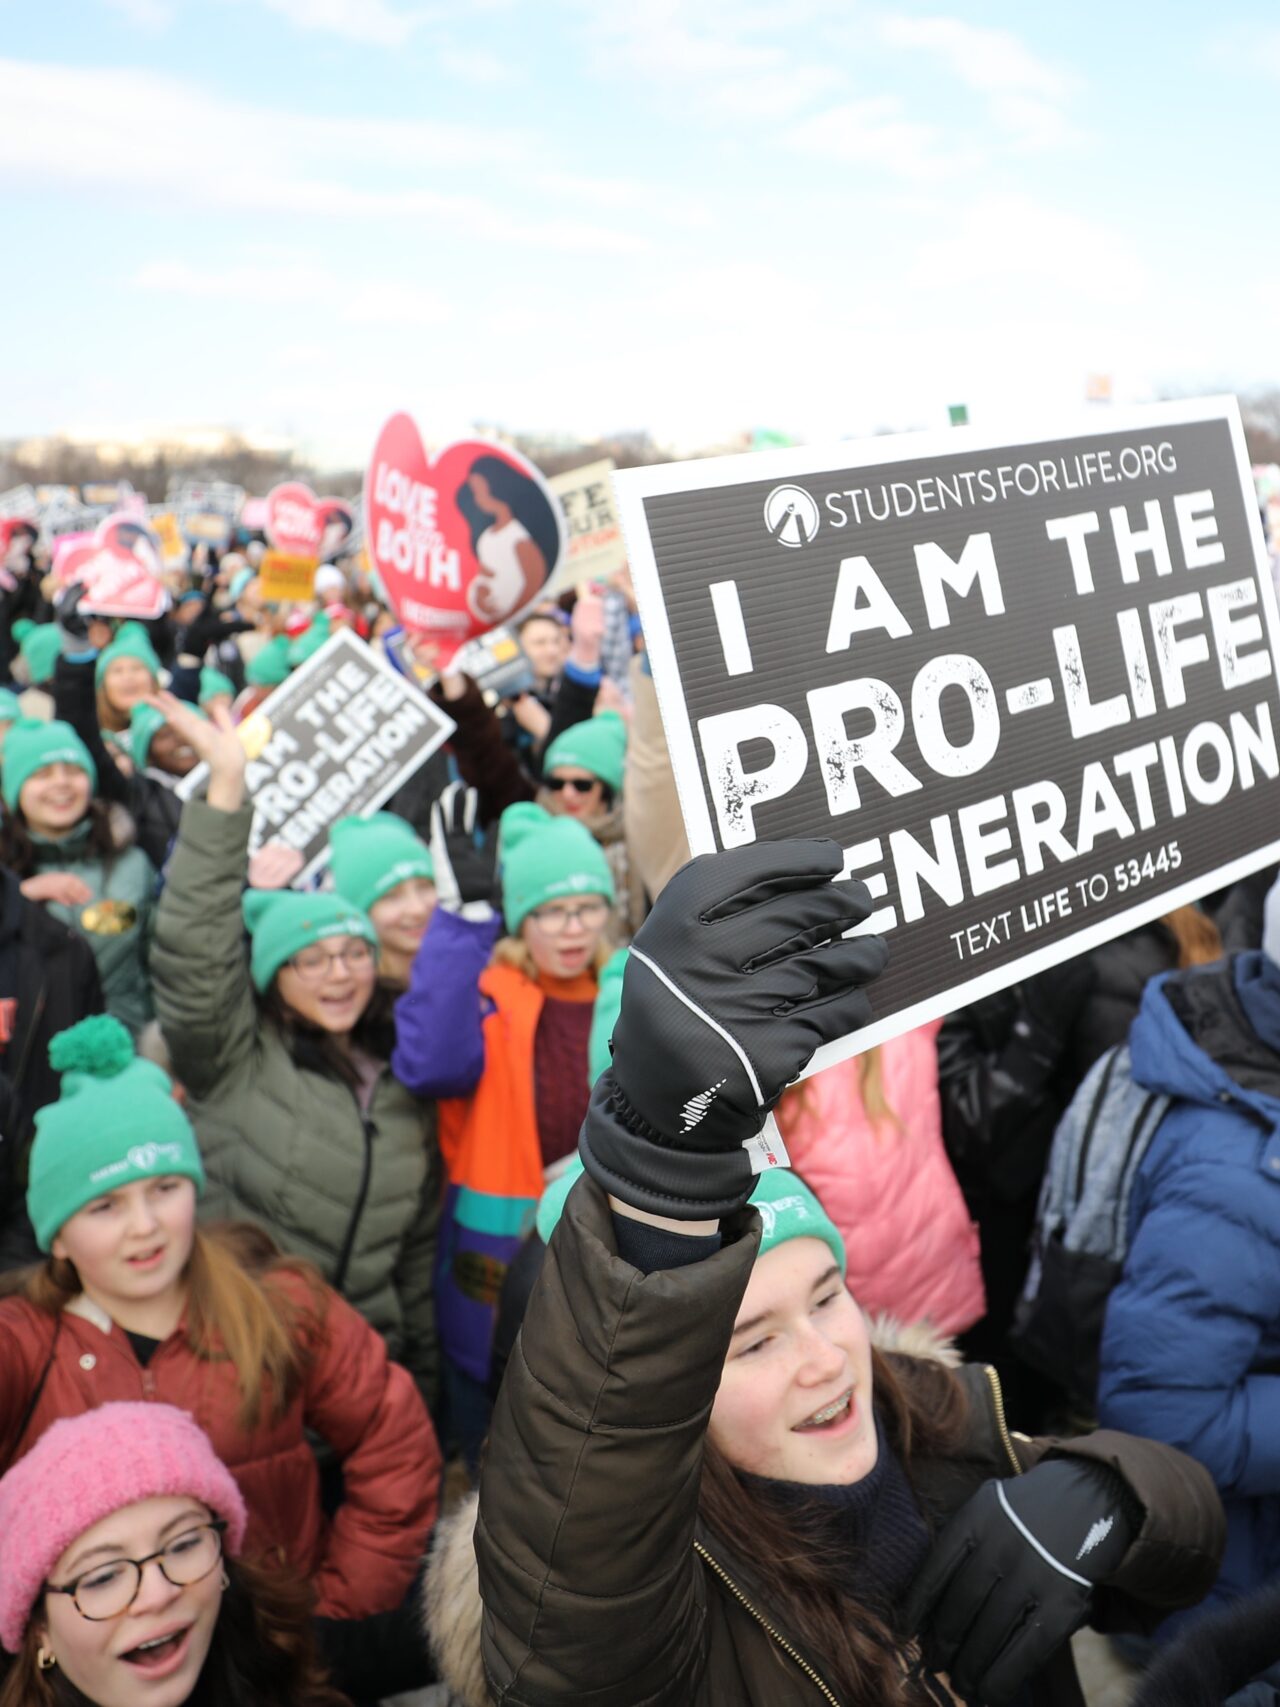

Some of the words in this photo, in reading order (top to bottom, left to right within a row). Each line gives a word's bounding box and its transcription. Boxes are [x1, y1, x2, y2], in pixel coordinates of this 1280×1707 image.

[375, 461, 438, 525] LOVE
[376, 517, 462, 592] BOTH
[708, 580, 754, 676] I
[825, 531, 1006, 654] AM
[1045, 489, 1226, 595] THE
[244, 729, 298, 793] AM
[294, 660, 371, 729] THE
[697, 577, 1272, 849] PRO-LIFE
[812, 703, 1279, 949] ENERATION
[950, 911, 1012, 960] TEXT
[1020, 887, 1073, 933] LIFE
[1076, 873, 1109, 908] TO
[1114, 841, 1182, 892] 53445
